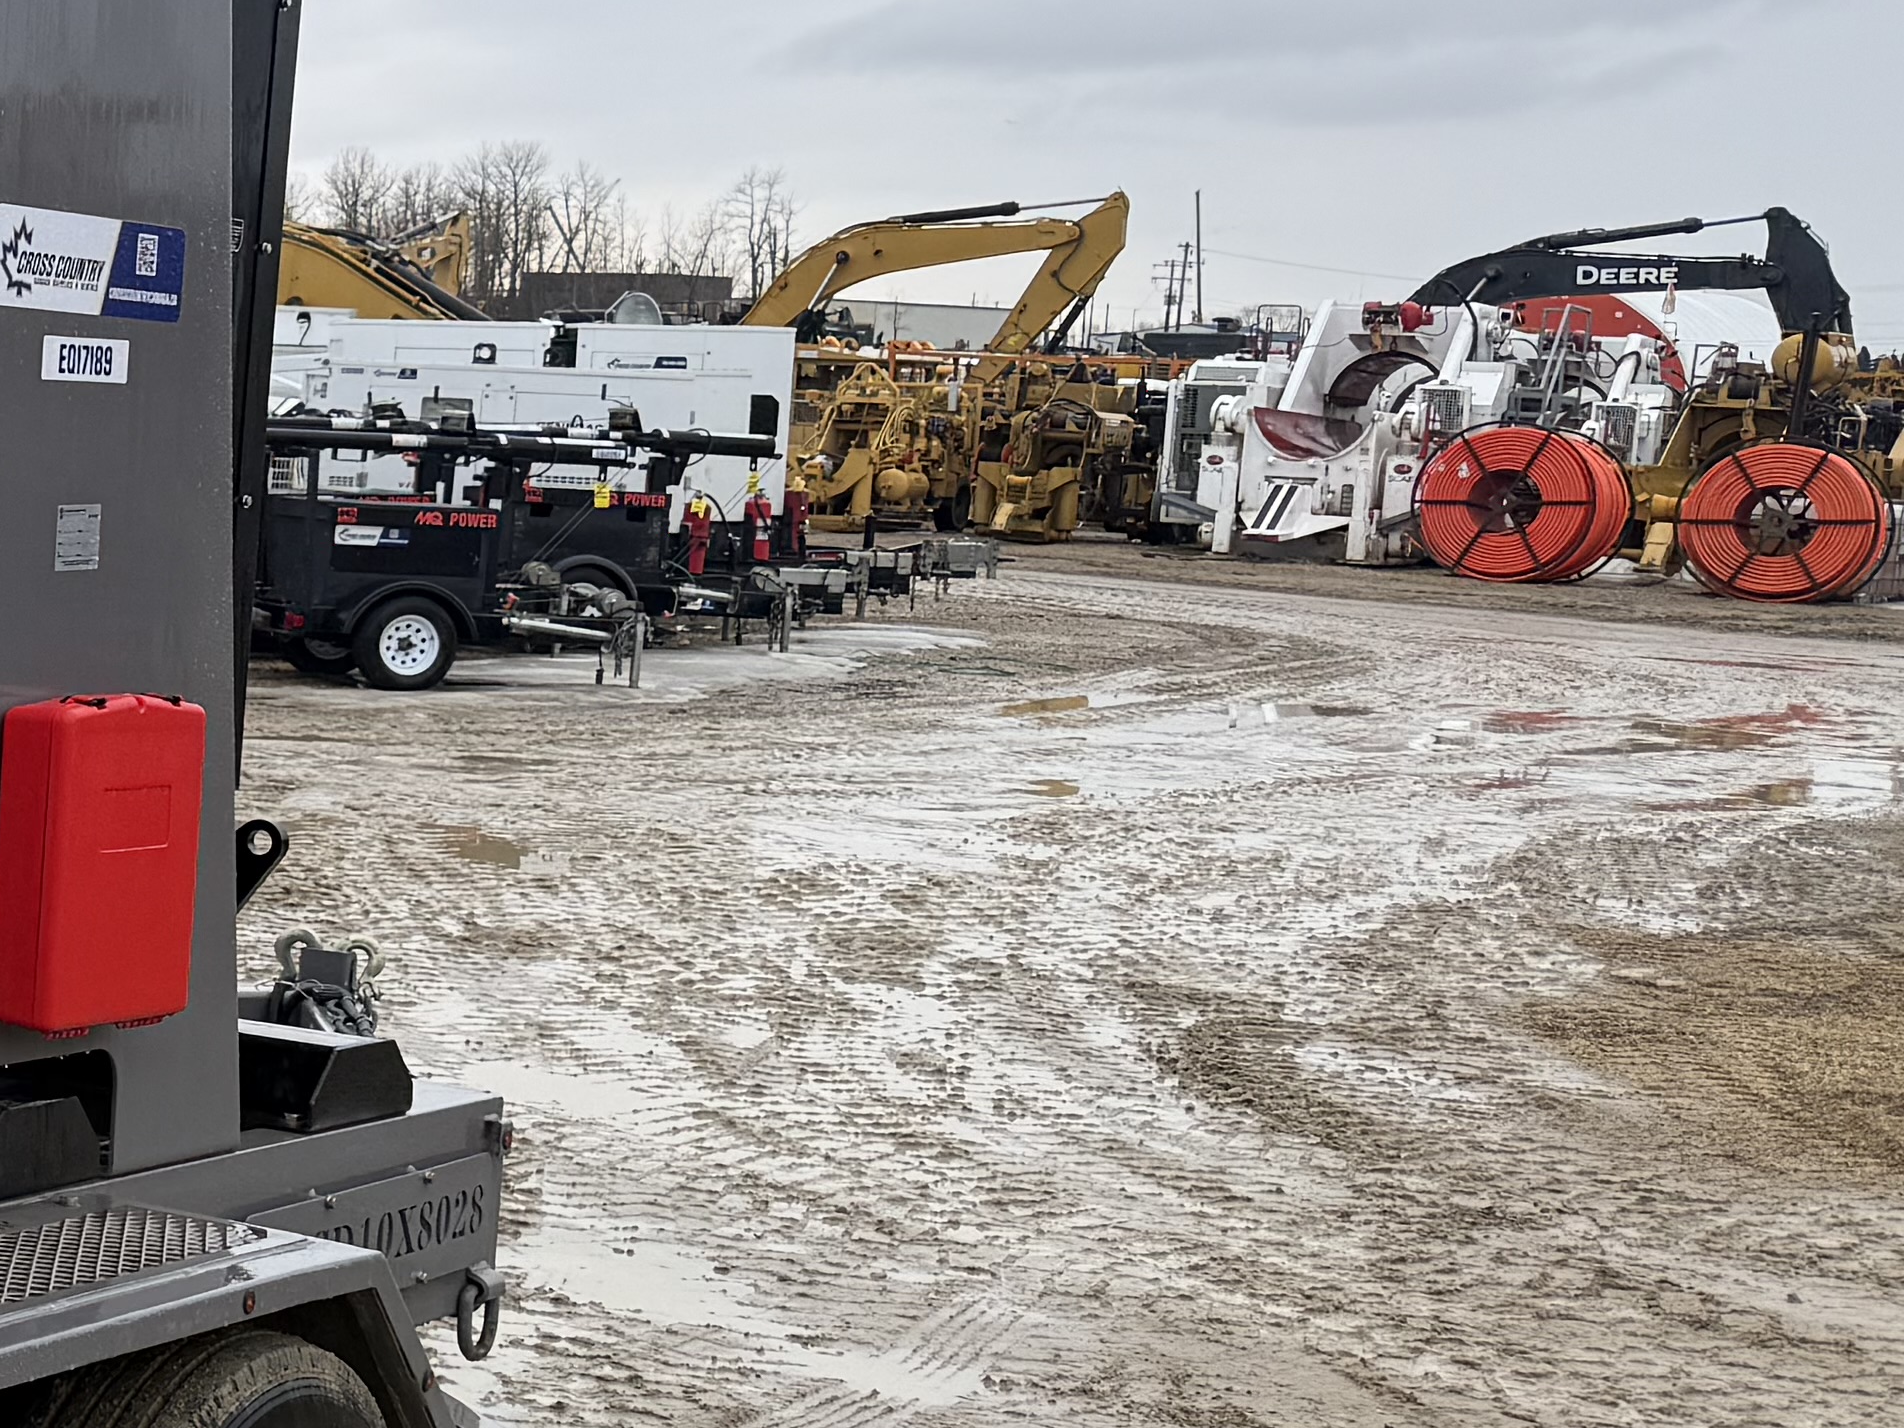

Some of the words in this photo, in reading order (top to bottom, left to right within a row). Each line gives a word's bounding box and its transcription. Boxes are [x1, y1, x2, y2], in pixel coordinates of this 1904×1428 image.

[16, 250, 57, 277] CROSS
[54, 256, 106, 283] COUNTRY
[1576, 265, 1679, 285] DEERE
[624, 493, 666, 508] POWER
[414, 510, 444, 526] MQ
[449, 512, 497, 528] POWER
